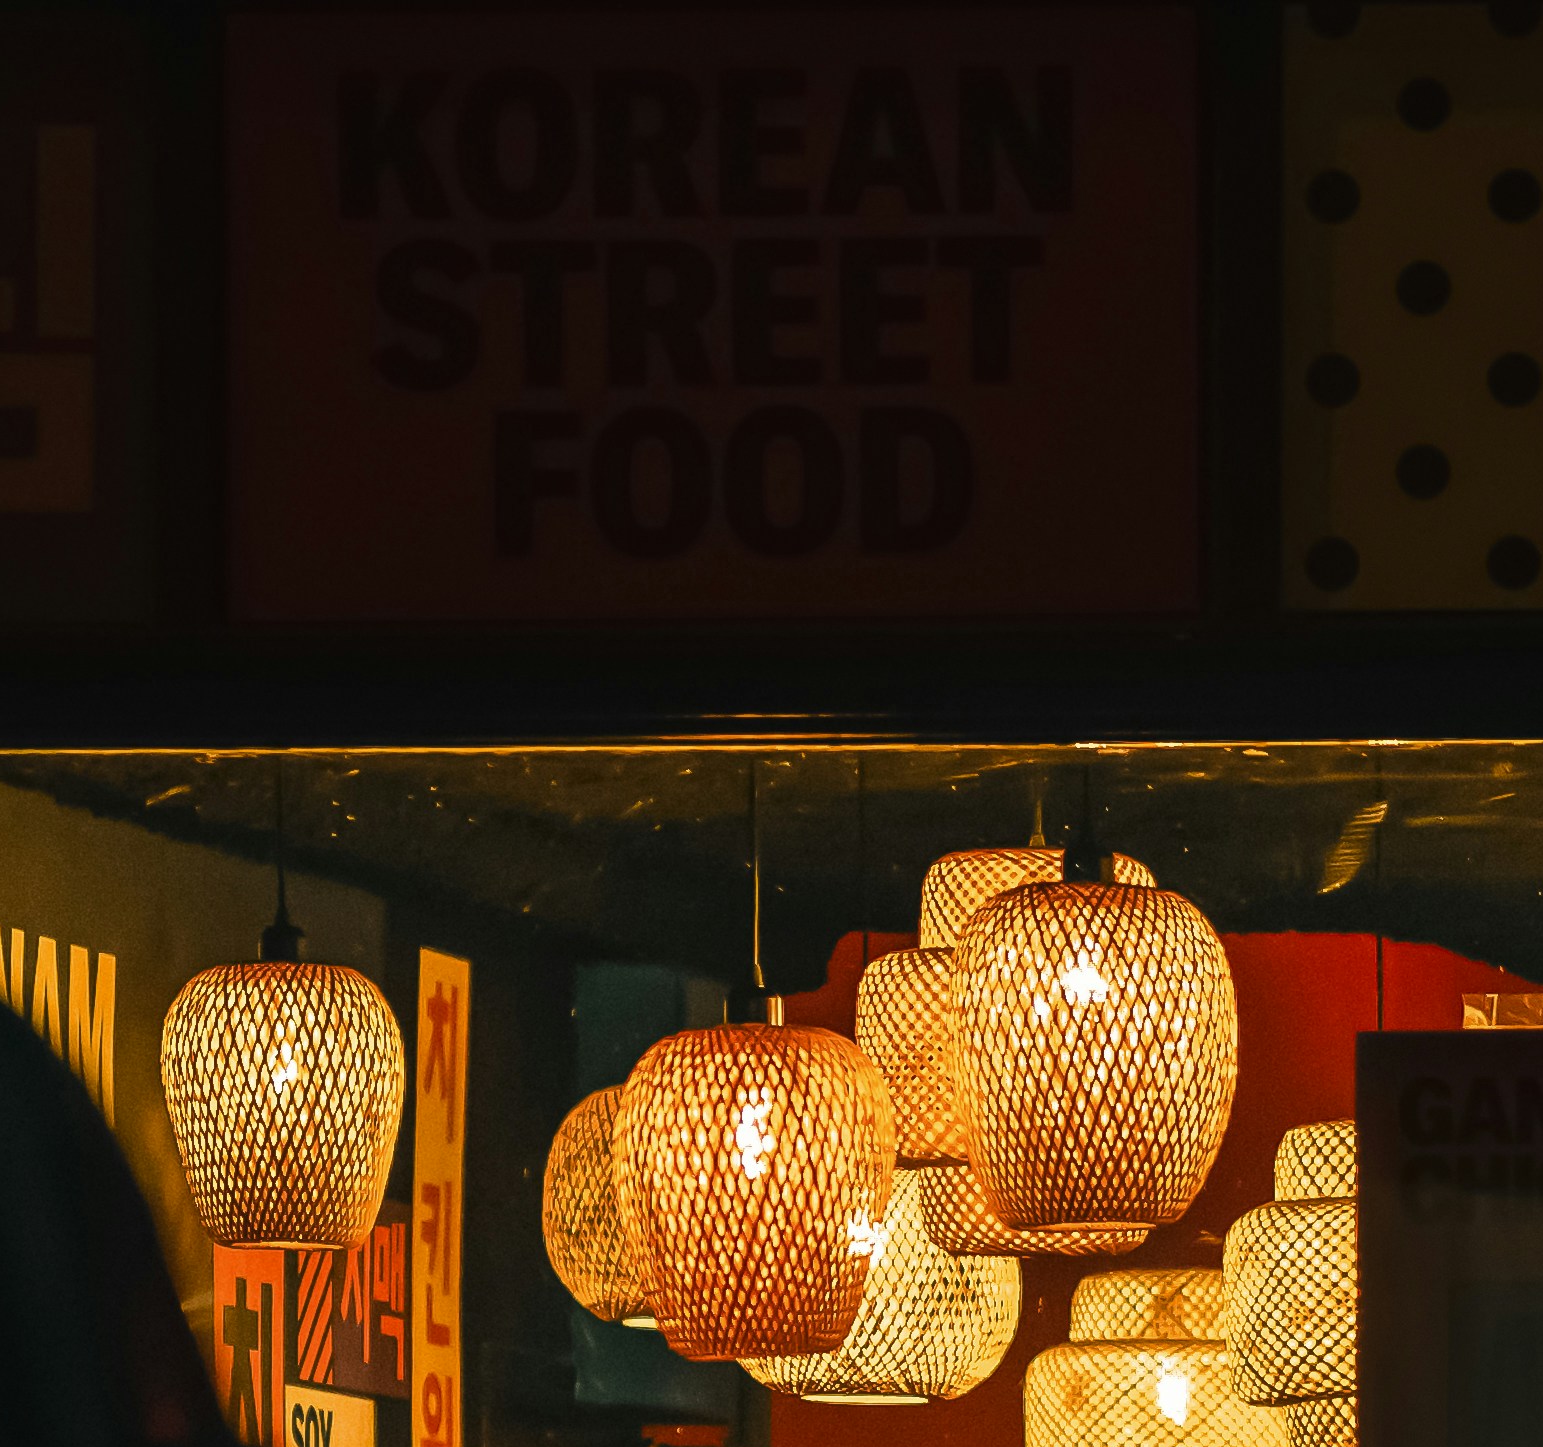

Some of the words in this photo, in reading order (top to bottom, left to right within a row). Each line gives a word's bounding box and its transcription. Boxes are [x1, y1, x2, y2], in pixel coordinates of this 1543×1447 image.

[335, 66, 1073, 221] KOREAN
[370, 235, 1044, 391] STREET
[493, 406, 975, 562] FOOD
